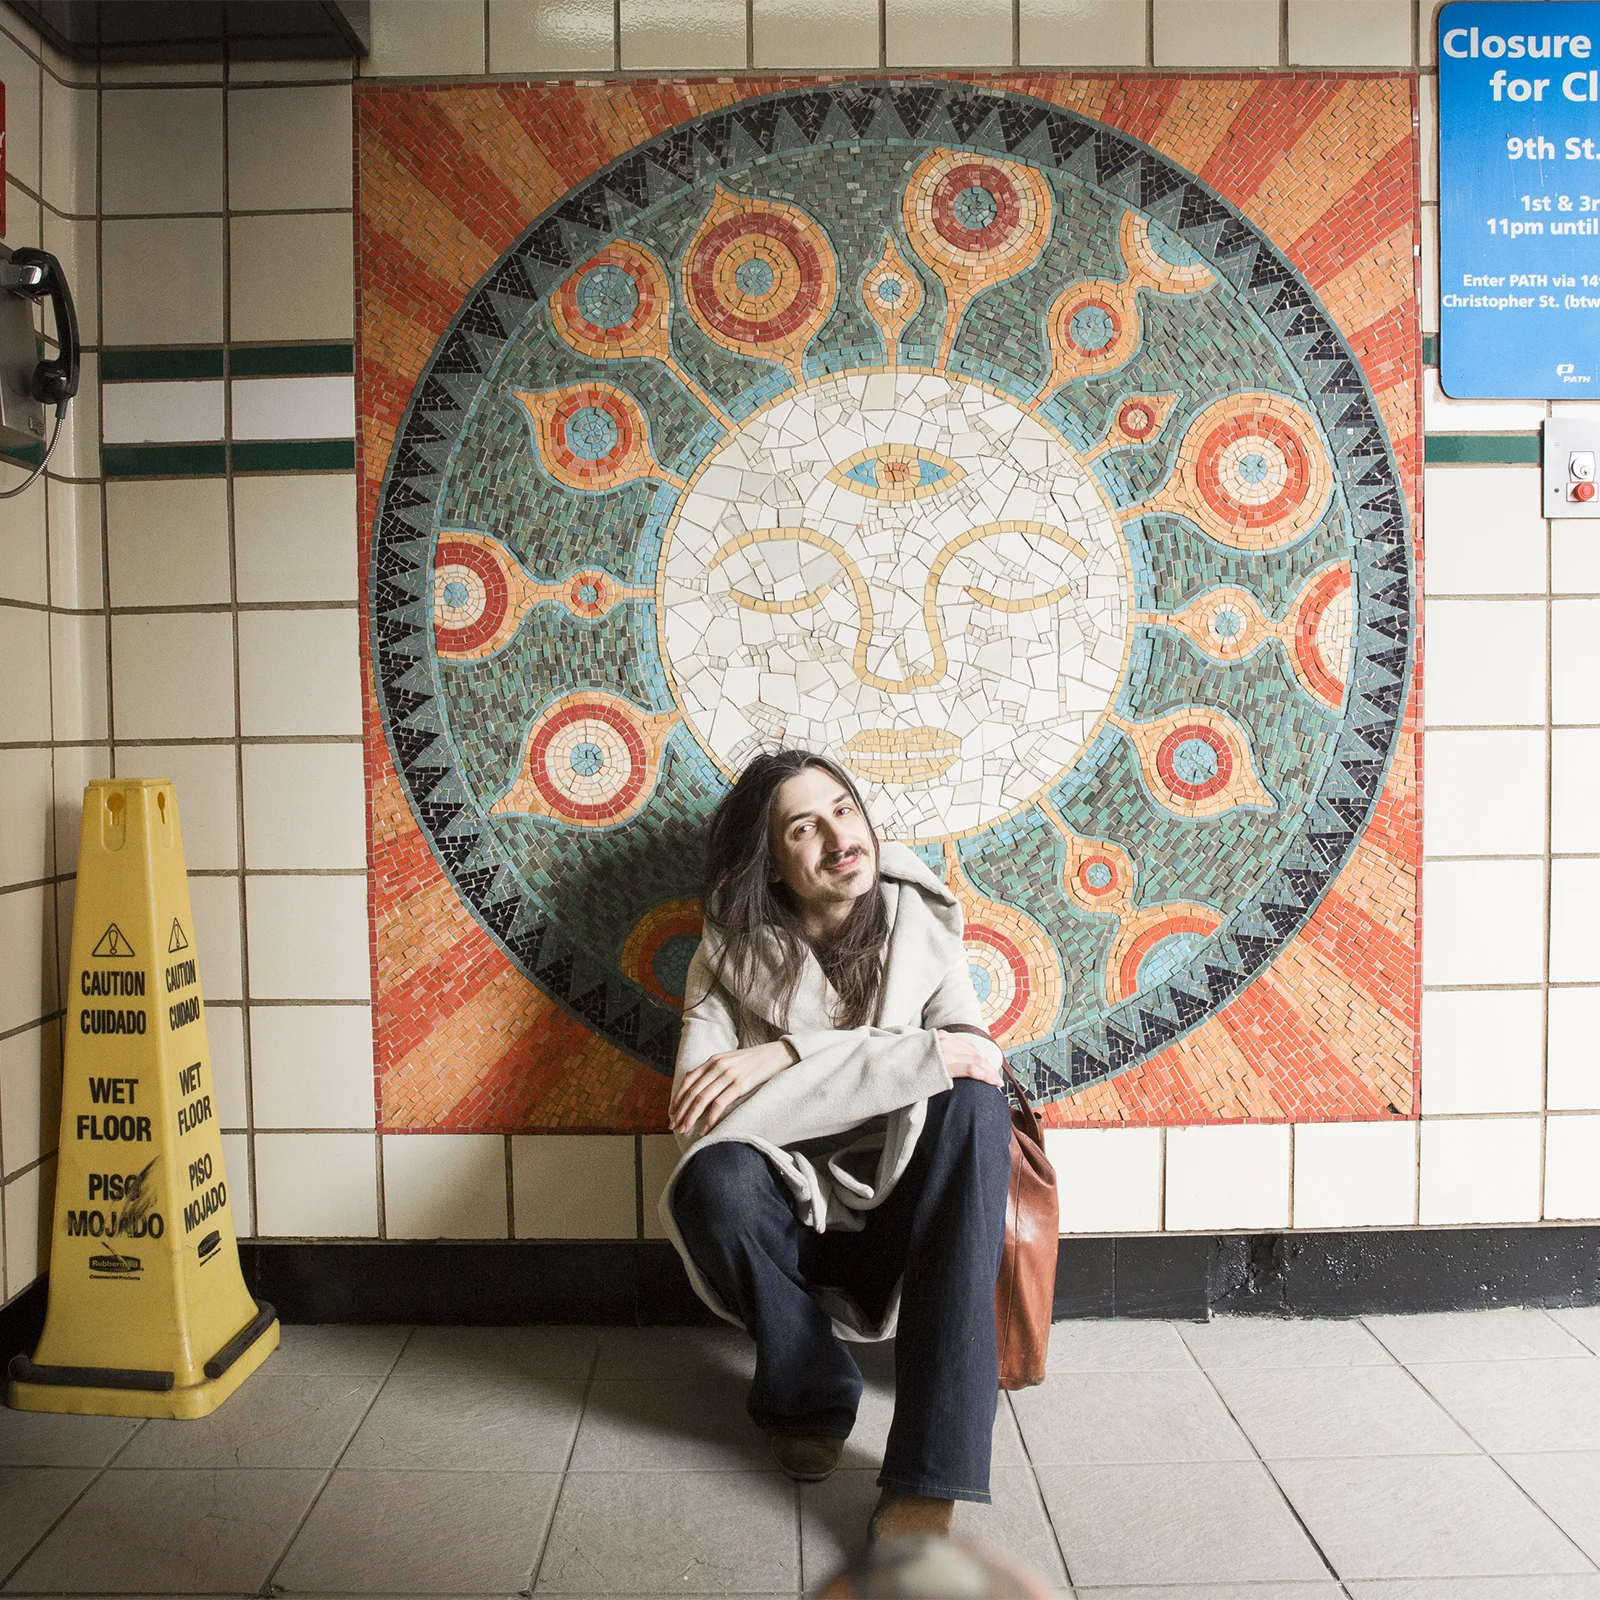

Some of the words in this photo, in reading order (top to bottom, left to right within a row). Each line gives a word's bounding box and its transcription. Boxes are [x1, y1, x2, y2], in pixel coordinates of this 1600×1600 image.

[1443, 27, 1592, 59] Closure
[1489, 70, 1550, 102] for
[1562, 70, 1598, 102] Cl
[1507, 136, 1555, 160] 9th
[1565, 137, 1600, 160] St.
[1521, 195, 1552, 212] 1st
[1557, 195, 1573, 212] &
[1579, 195, 1600, 212] 3r
[1487, 218, 1544, 239] 11pm
[1550, 218, 1599, 234] until
[1463, 274, 1505, 287] Enter
[1509, 274, 1548, 287] PATH
[1551, 274, 1576, 287] via
[1580, 274, 1600, 287] 14
[1442, 294, 1534, 310] Christopher
[1538, 295, 1560, 308] St.
[1564, 294, 1600, 310] (btw
[81, 970, 145, 997] CAUTION
[165, 959, 197, 993] CAUTION
[80, 1009, 146, 1035] CUIDADO
[169, 996, 200, 1031] CUIDADO
[89, 1077, 139, 1104] WET
[179, 1062, 202, 1097] WET
[77, 1115, 152, 1141] FLOOR
[178, 1095, 213, 1136] FLOOR
[189, 1153, 212, 1191] PISO
[89, 1174, 140, 1201] PISO
[183, 1181, 227, 1234] MOJADO
[67, 1210, 164, 1239] MOJADO
